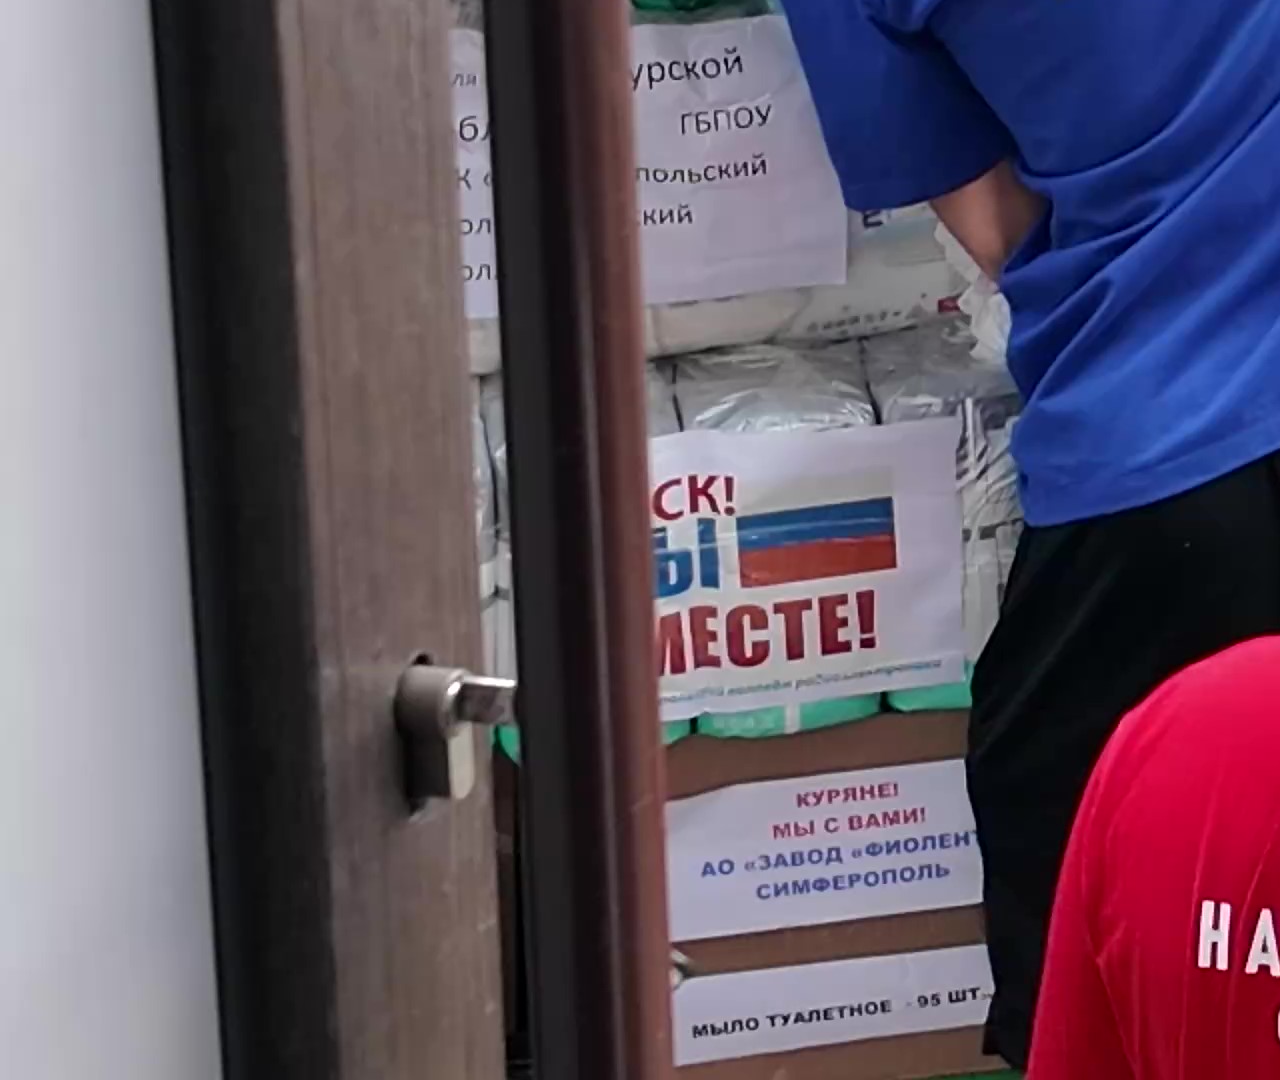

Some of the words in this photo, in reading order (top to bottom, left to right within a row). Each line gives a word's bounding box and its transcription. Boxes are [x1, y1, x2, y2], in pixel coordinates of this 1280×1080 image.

[680, 104, 772, 135] ГБПОУ
[643, 203, 693, 226] кий
[652, 475, 737, 521] СК!
[652, 517, 720, 600] Ы
[658, 589, 877, 677] МЕСТЕ!
[796, 782, 899, 808] КУРЯНЕ!
[772, 819, 815, 840] МЫ
[824, 816, 839, 833] С
[848, 807, 926, 831] ВАМИ!
[701, 859, 735, 878] АО
[744, 846, 843, 872] «ЗАВОД
[756, 863, 951, 900] СИМФЕРОПОЛЬ
[692, 1017, 760, 1039] МЫЛО
[766, 1000, 892, 1028] ТУАЛЕТНОЕ
[917, 994, 941, 1008] 95
